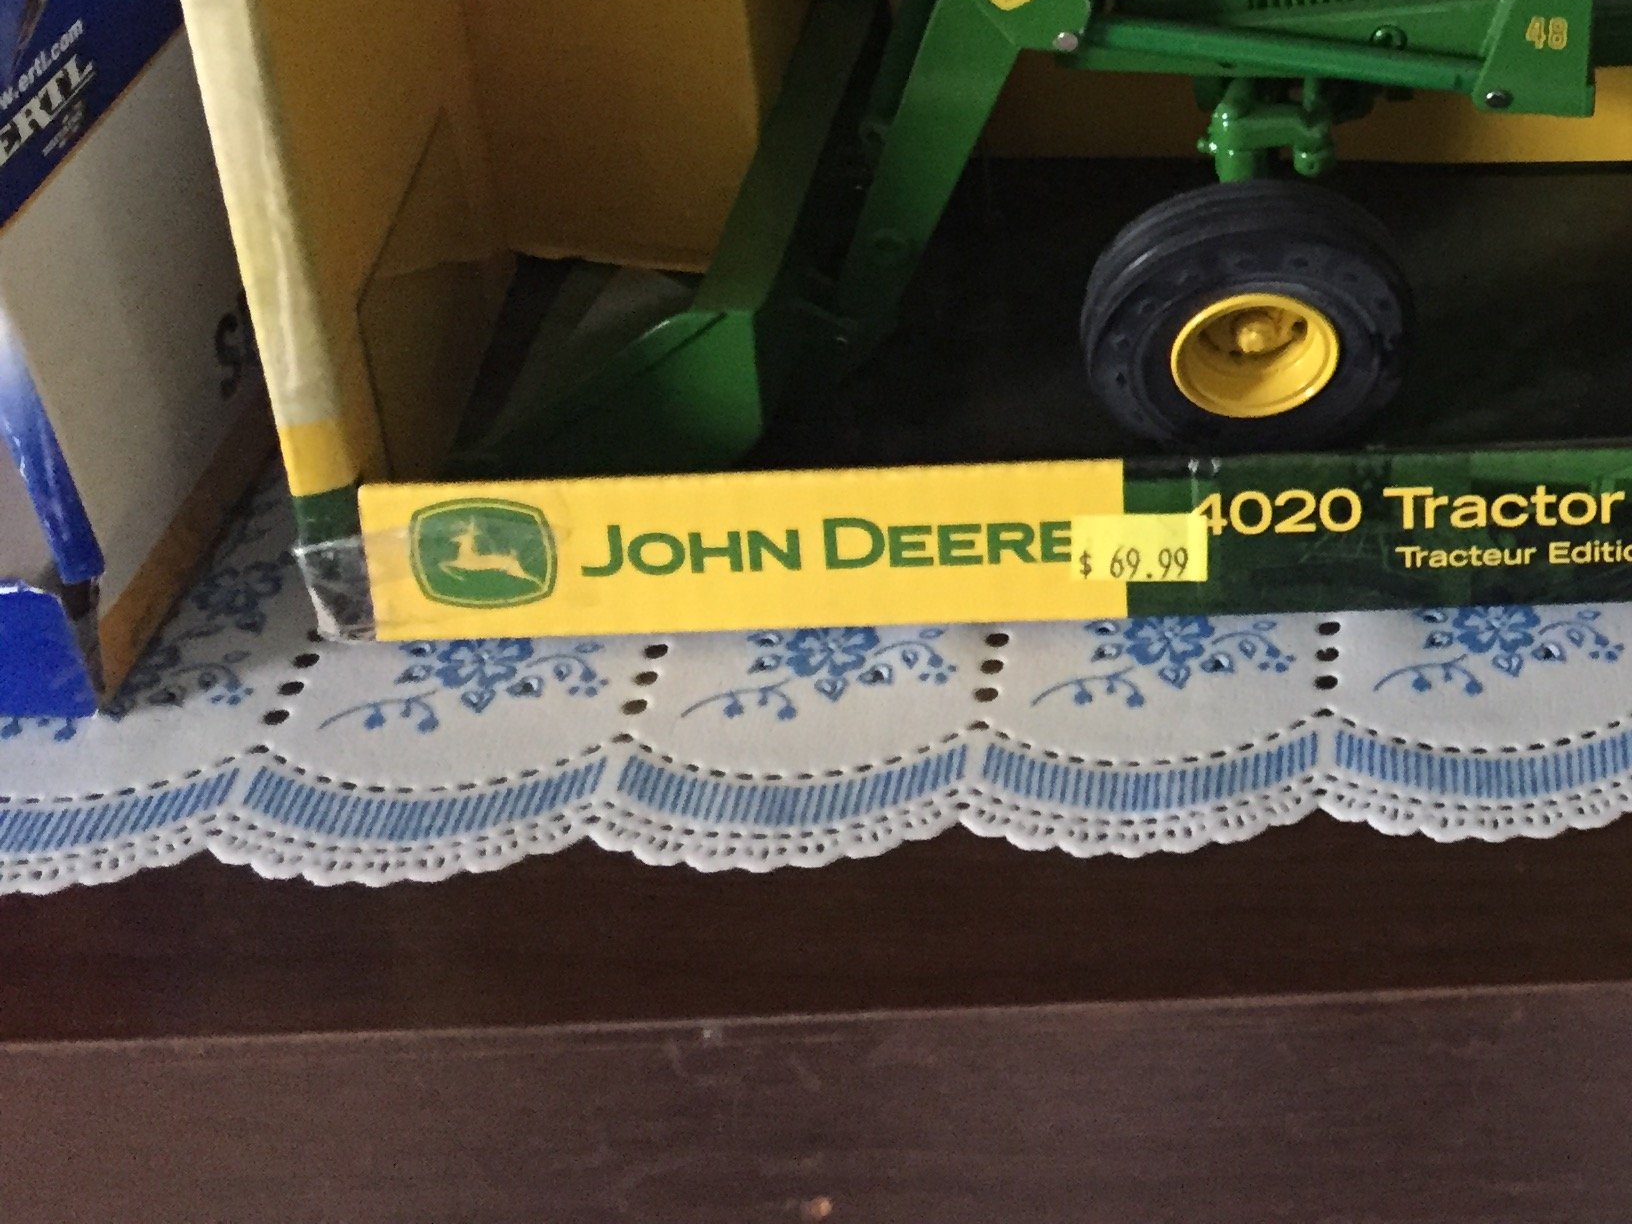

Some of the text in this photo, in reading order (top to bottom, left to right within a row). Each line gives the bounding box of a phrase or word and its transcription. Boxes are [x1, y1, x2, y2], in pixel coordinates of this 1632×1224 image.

[1525, 15, 1569, 50] 48
[1198, 487, 1363, 537] 4020
[581, 515, 1072, 577] JOHN DEERE
[1109, 545, 1189, 580] 69.99
[1395, 542, 1539, 570] Tracteur
